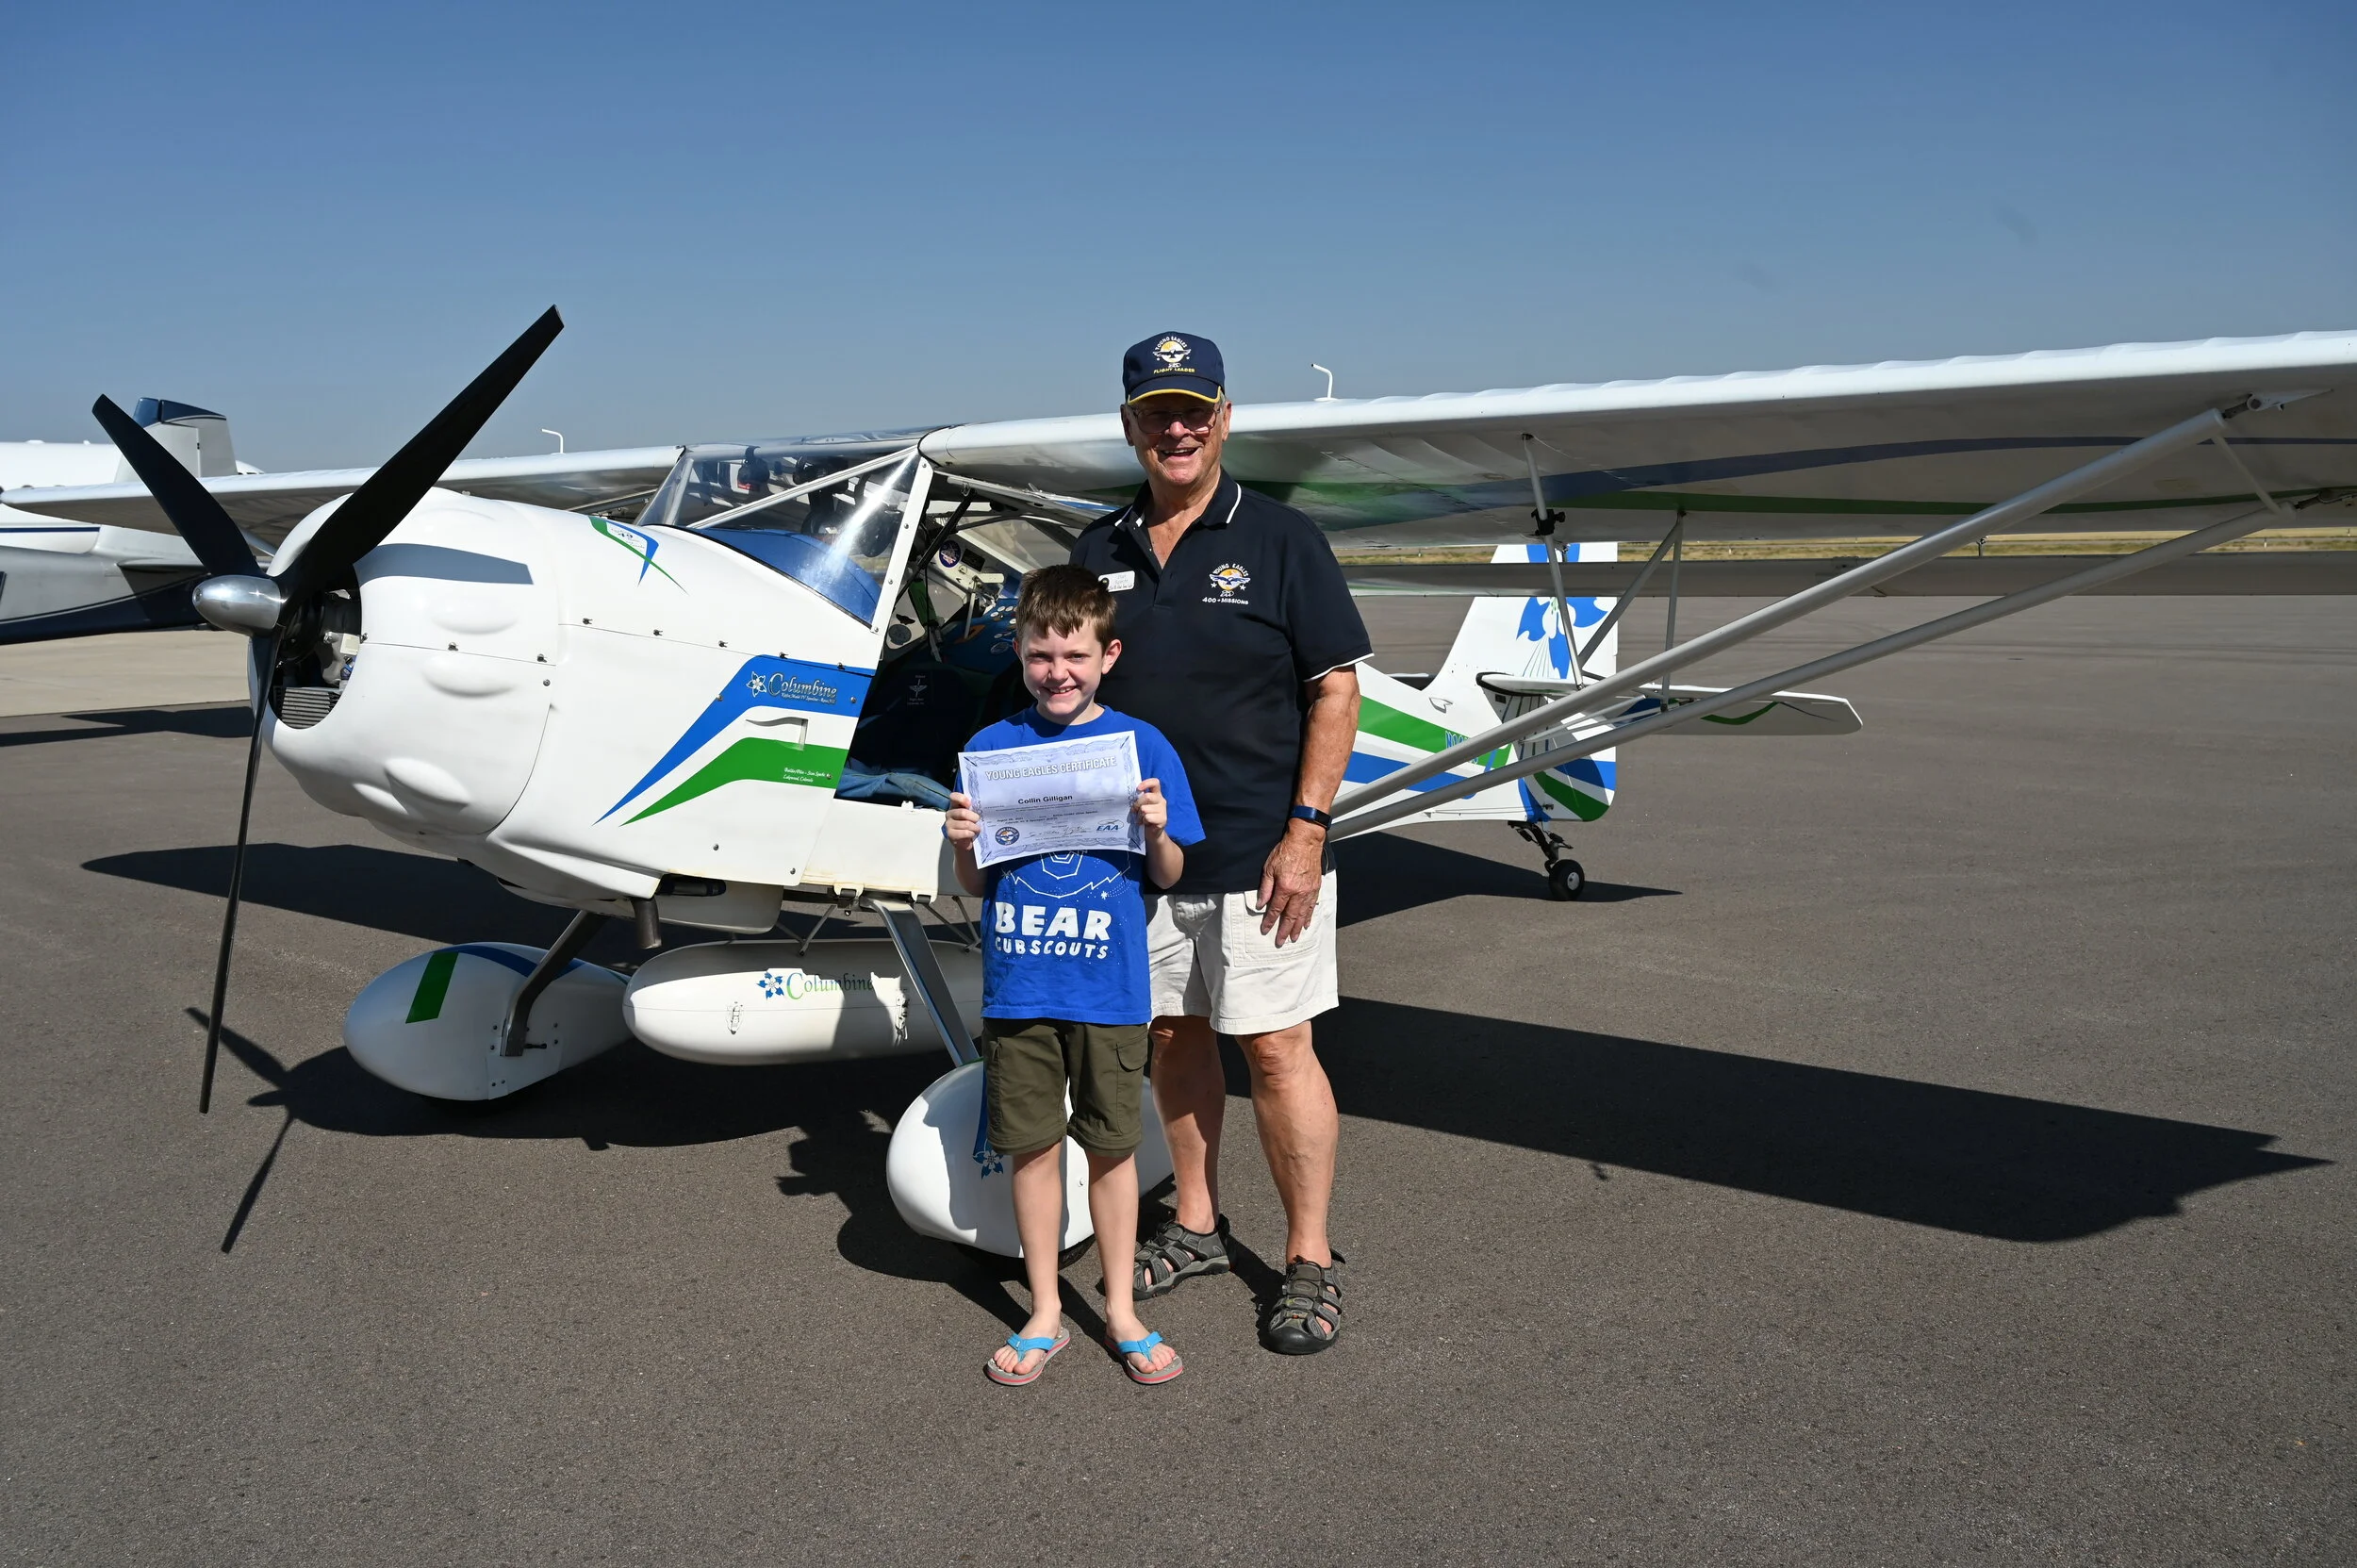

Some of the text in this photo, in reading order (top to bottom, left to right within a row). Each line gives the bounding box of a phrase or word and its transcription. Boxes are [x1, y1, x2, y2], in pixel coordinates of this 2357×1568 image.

[1155, 336, 1188, 350] YOUNG EAGLES
[1231, 563, 1249, 577] EAGLES
[768, 672, 837, 699] Columbine
[985, 756, 1117, 781] YOUNG EAGLES CERTIFICATE
[1017, 797, 1041, 805] Collin
[995, 901, 1112, 941] BEAR
[995, 936, 1109, 960] CUB SCOUTS
[786, 972, 873, 999] Columbine
